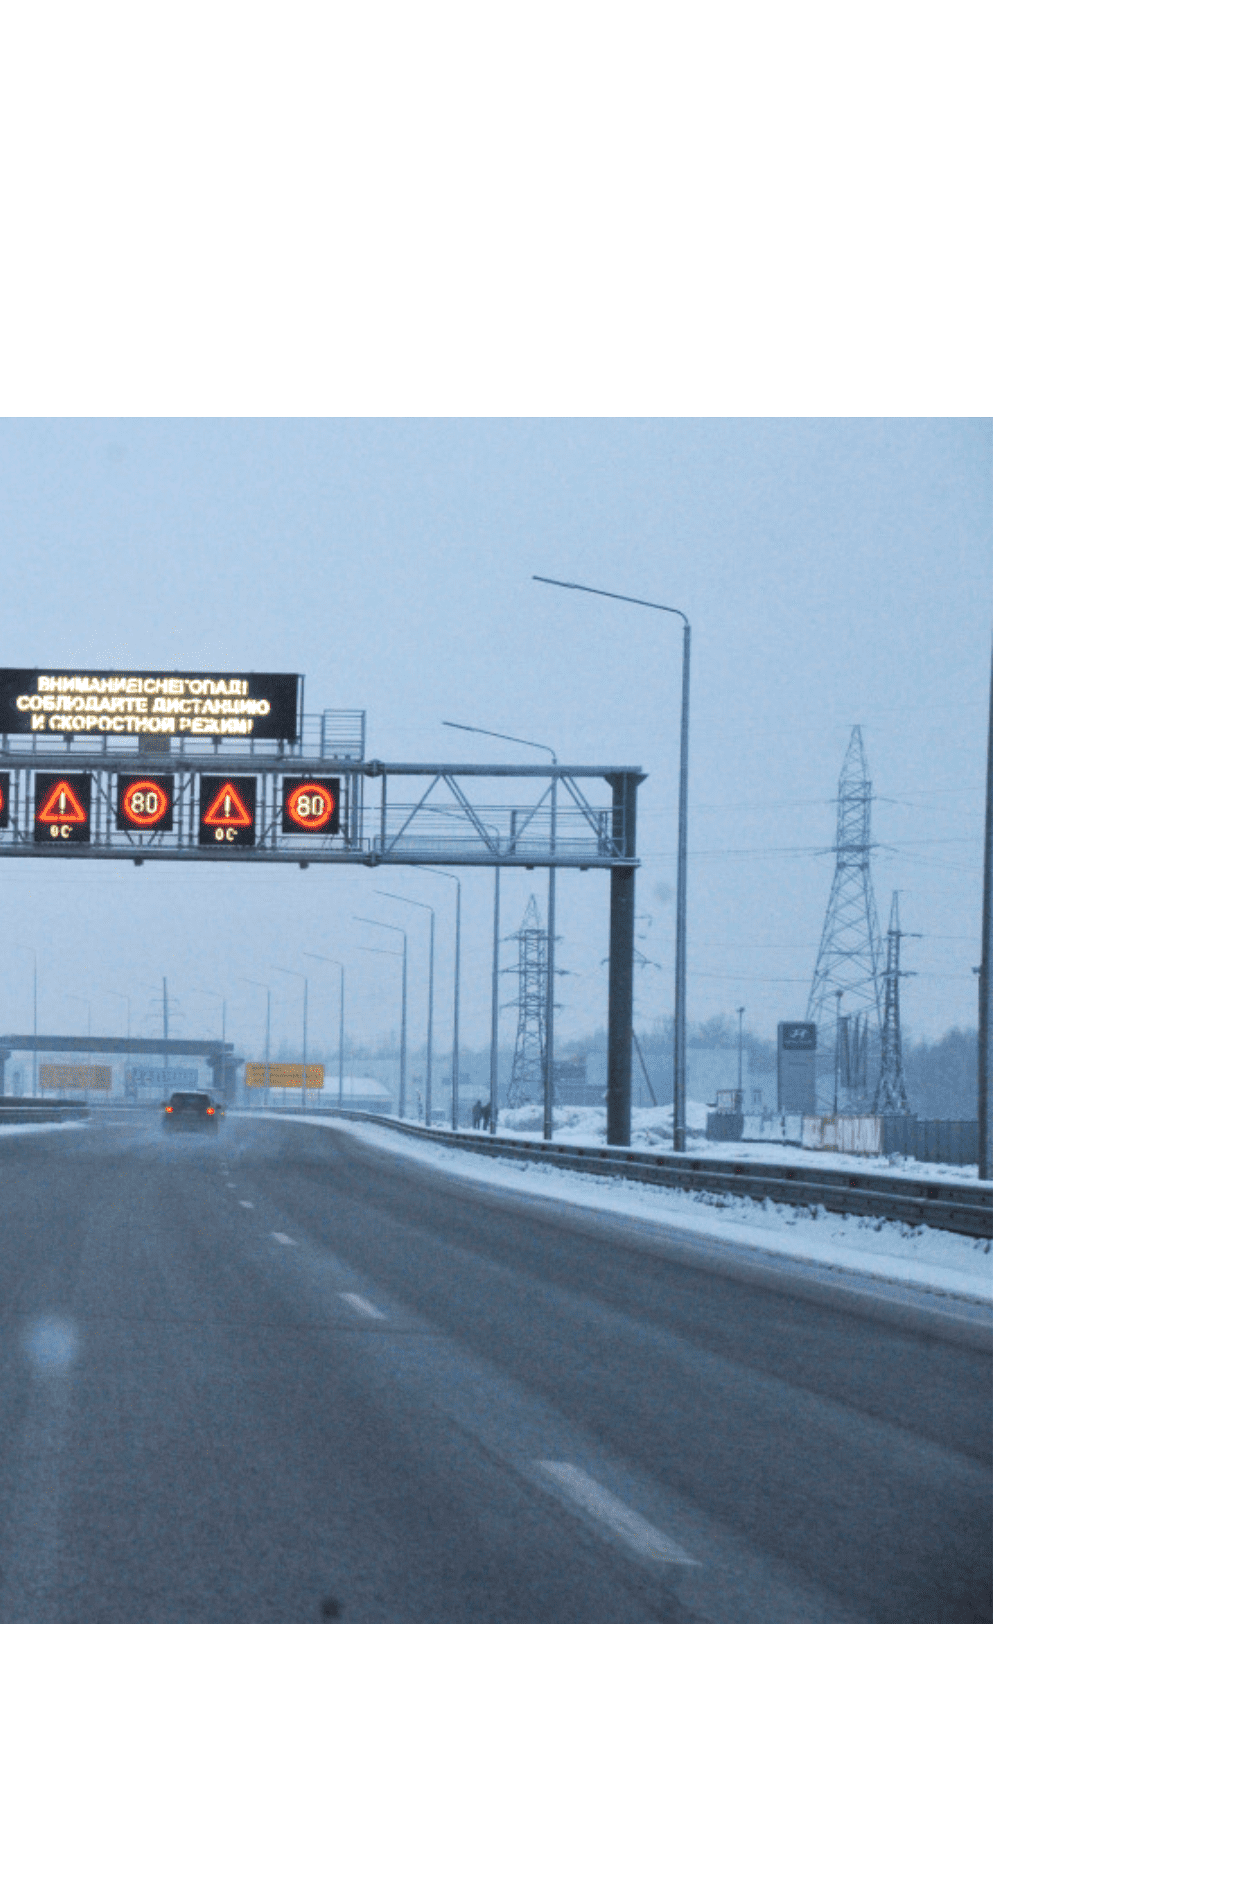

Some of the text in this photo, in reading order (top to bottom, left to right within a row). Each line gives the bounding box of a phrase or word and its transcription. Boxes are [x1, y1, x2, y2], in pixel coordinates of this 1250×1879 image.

[152, 697, 271, 716] ДИСТАНЦИЮ
[31, 714, 46, 731] И
[49, 714, 175, 733] СКОРОСТНОЙ
[131, 791, 158, 814] 80
[296, 794, 325, 818] 80
